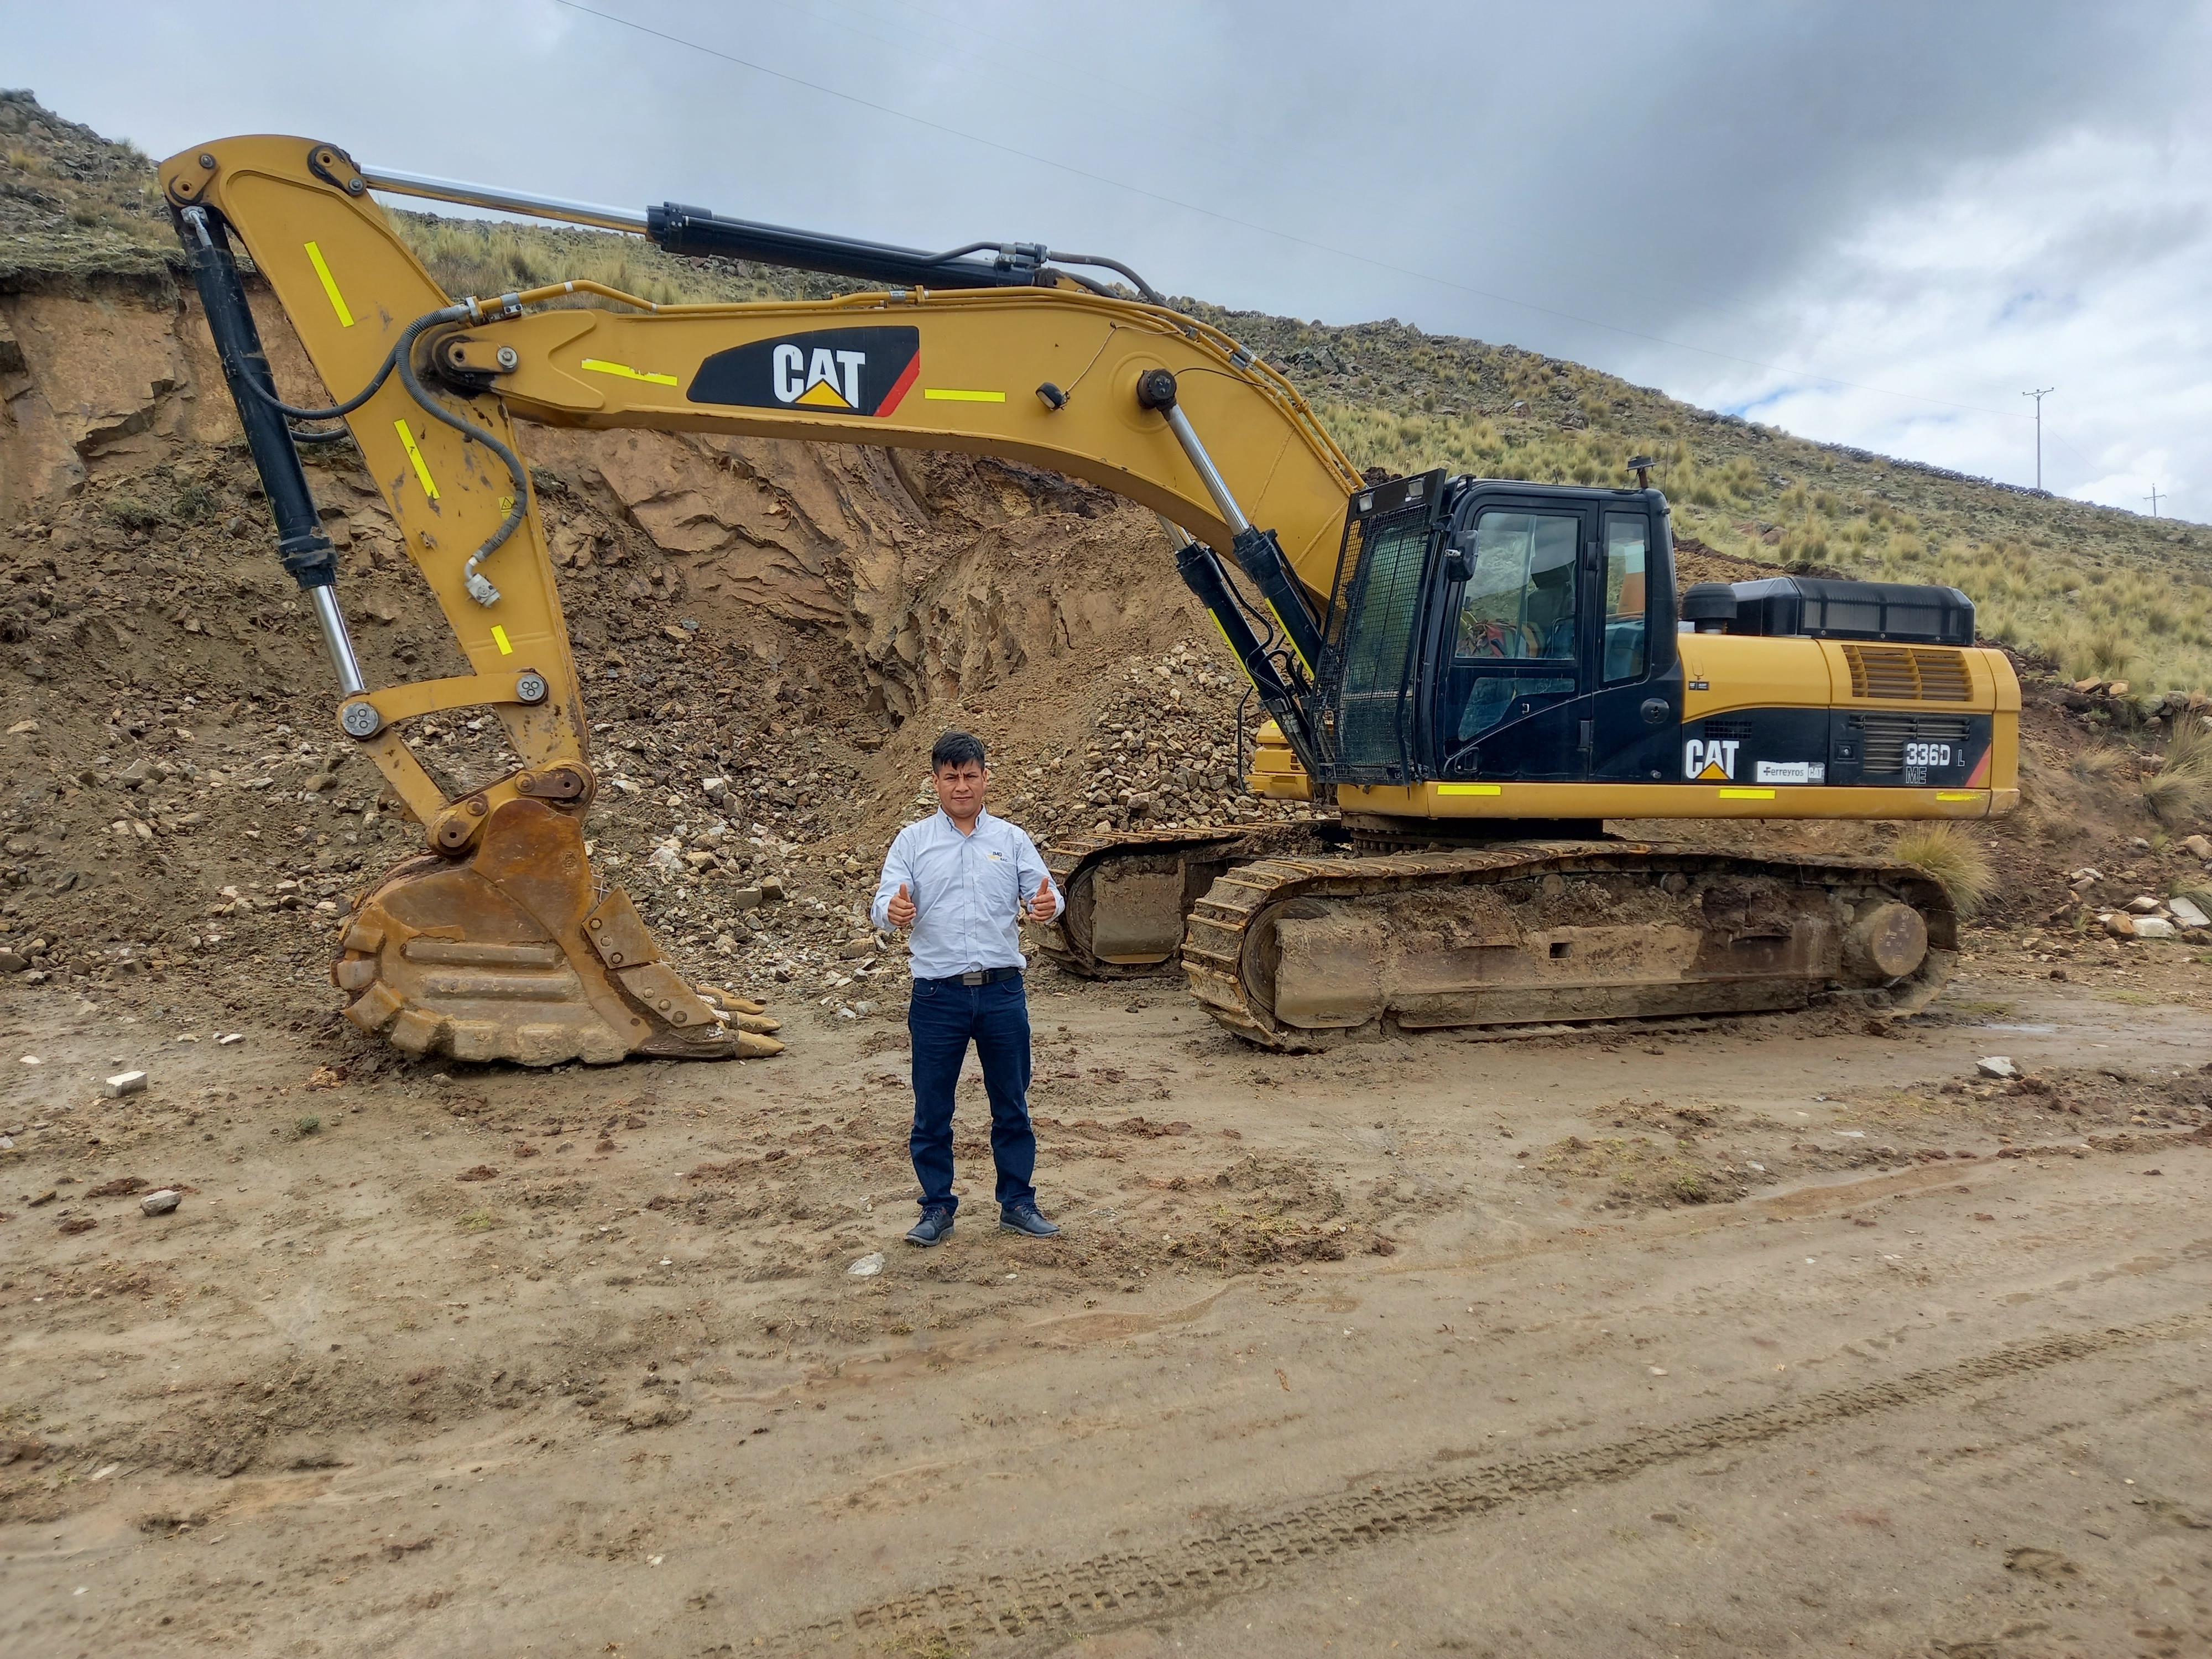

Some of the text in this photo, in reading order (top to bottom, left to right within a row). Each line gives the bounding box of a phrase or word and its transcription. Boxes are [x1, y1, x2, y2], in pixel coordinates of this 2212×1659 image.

[773, 343, 865, 409] CAT
[1686, 739, 1740, 780] CAT
[1906, 743, 1965, 766] 336D L
[1763, 766, 1804, 776] Ferreyros
[1808, 767, 1823, 779] CAT
[1905, 766, 1927, 784] ME
